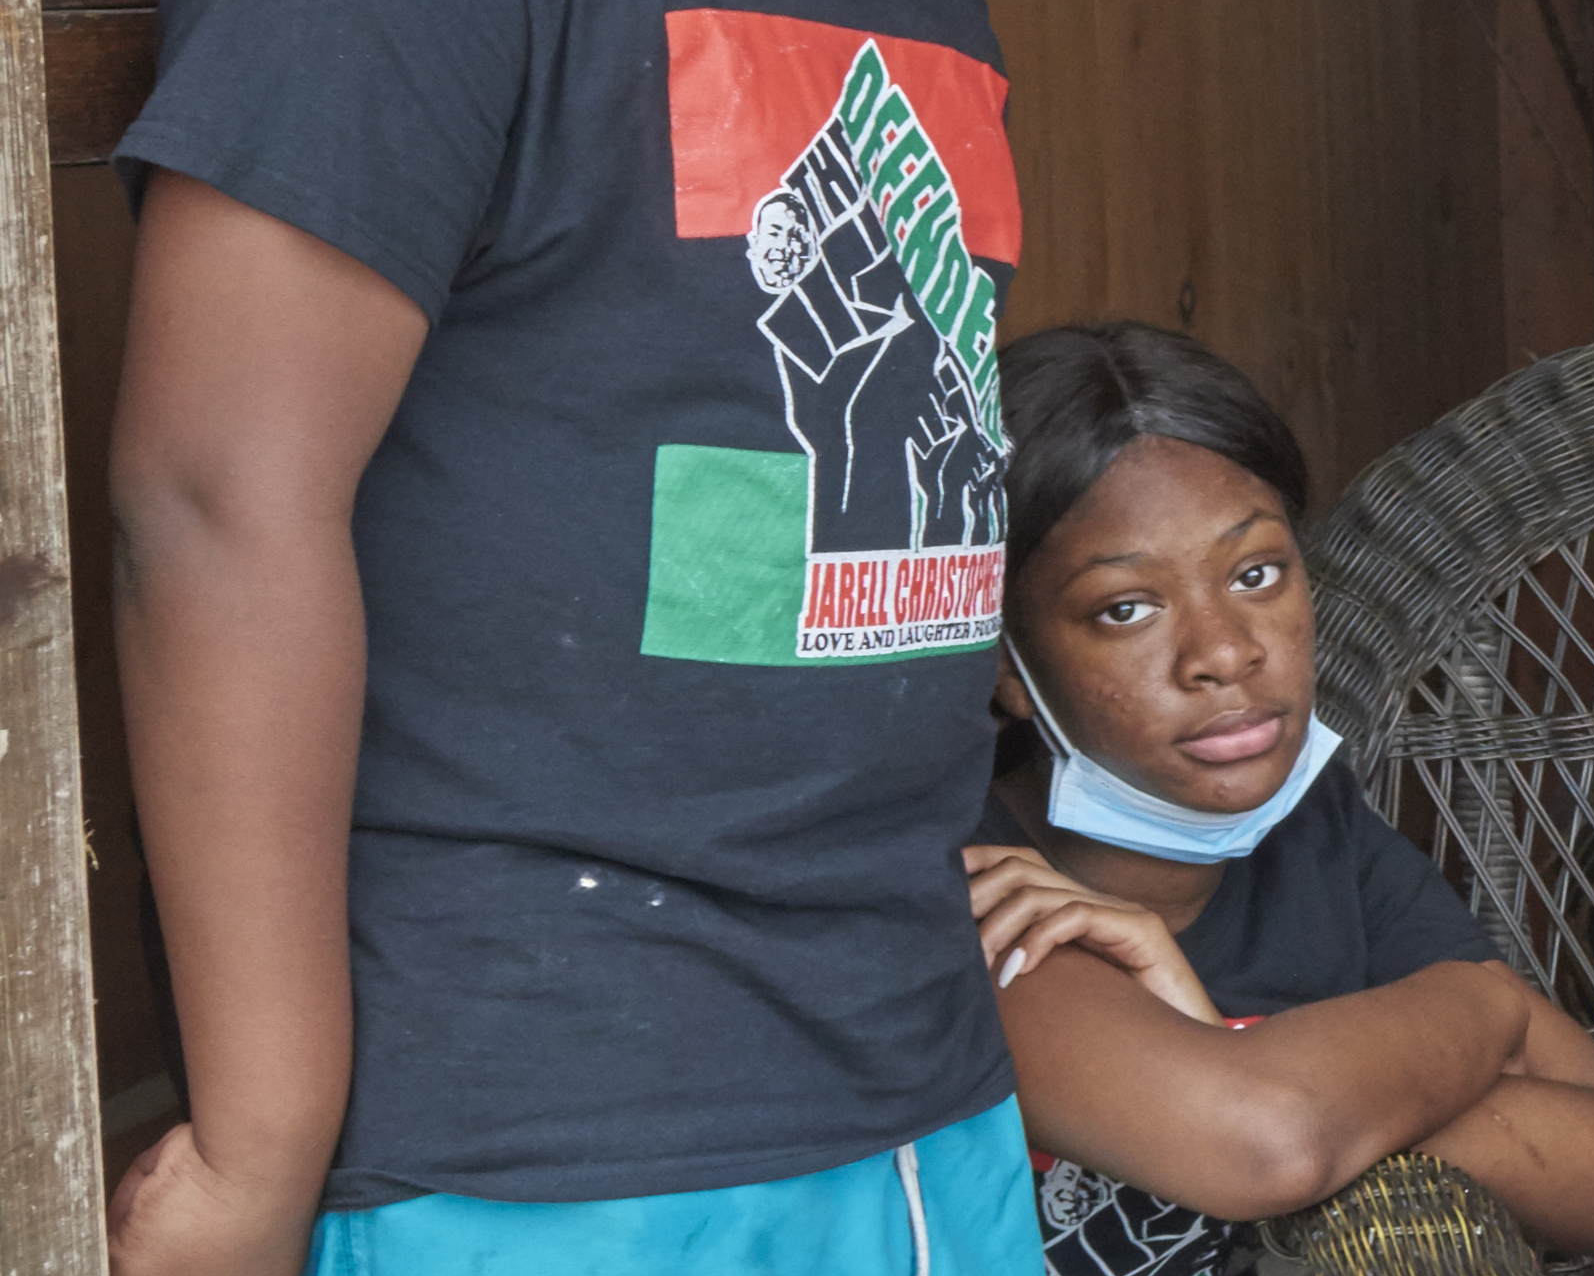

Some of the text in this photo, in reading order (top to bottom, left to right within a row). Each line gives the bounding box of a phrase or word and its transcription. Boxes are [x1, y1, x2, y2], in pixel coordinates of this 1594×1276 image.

[804, 560, 888, 629] JARELL
[801, 632, 856, 652] LOVE
[858, 629, 895, 650] AND
[899, 622, 970, 646] LAUGHTER
